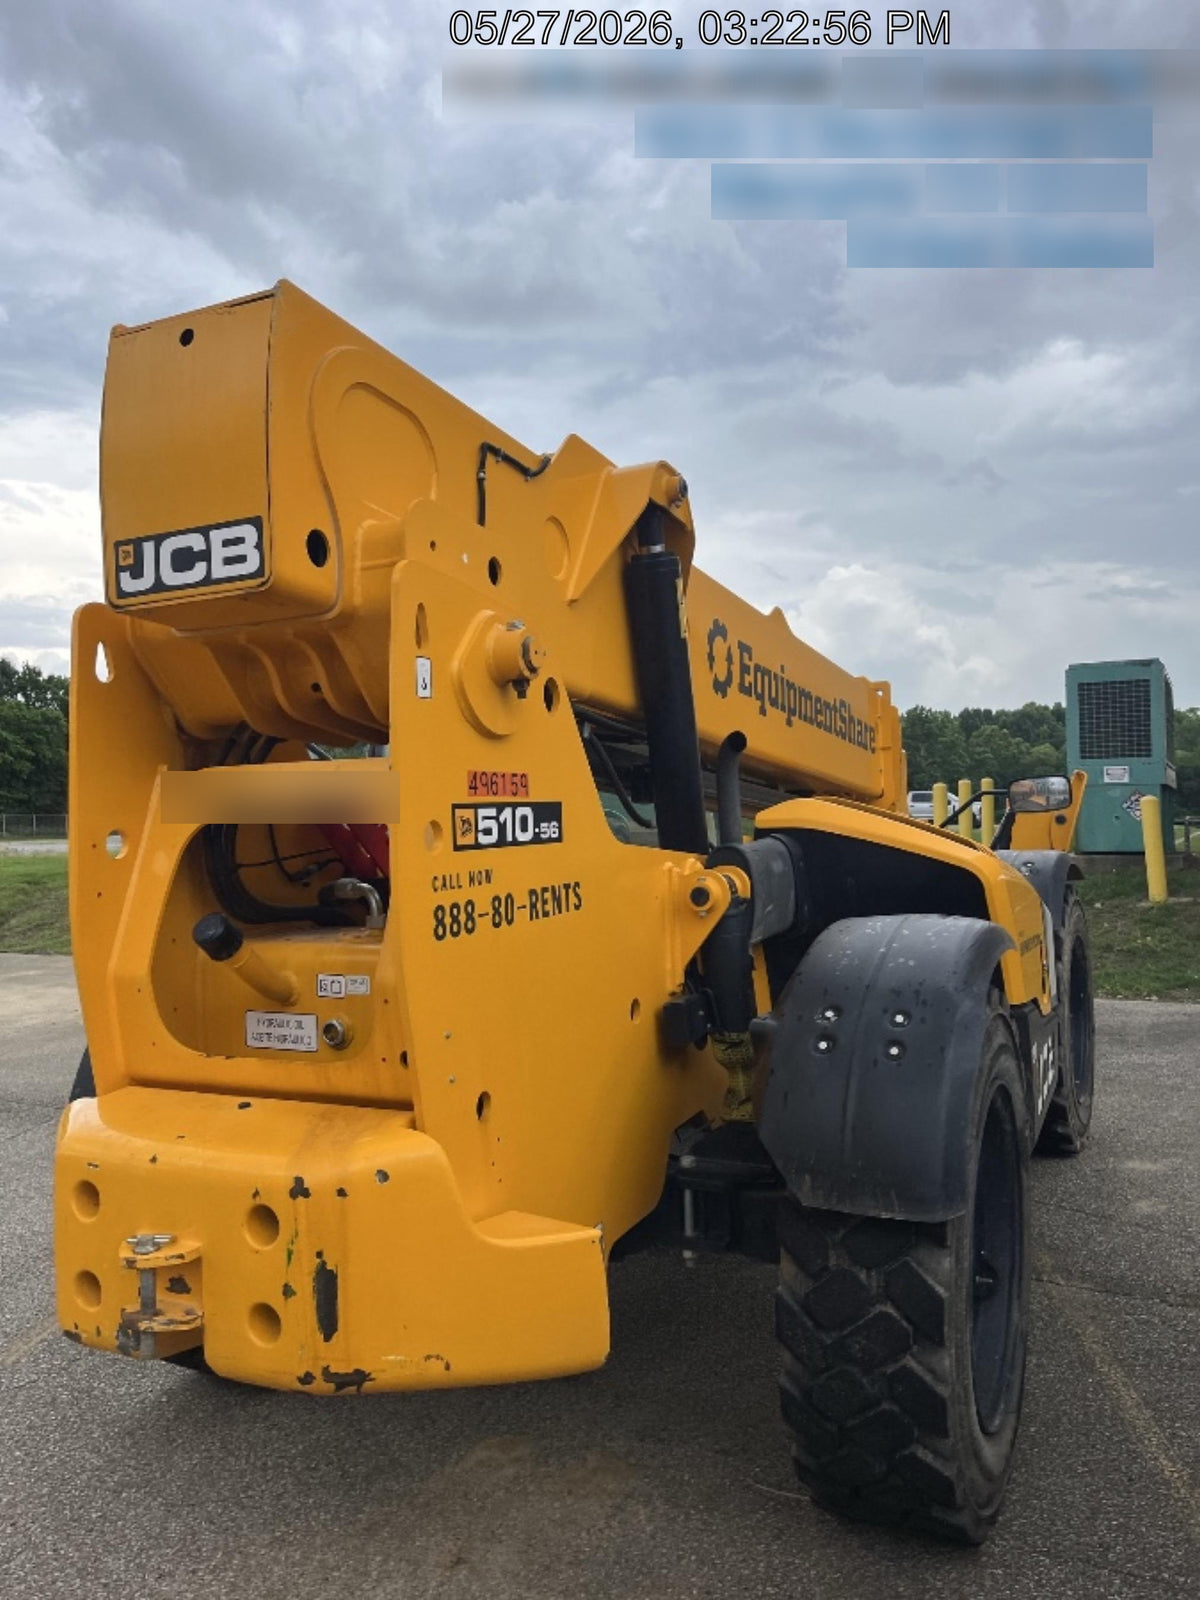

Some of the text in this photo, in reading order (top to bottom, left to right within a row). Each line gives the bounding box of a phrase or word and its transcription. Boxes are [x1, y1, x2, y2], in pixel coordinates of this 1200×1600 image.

[119, 524, 260, 593] JCB
[737, 639, 876, 755] EquipmentShare
[468, 771, 529, 797] 496159
[431, 868, 494, 893] CALL NOW
[433, 881, 583, 942] 888-80-RENTS
